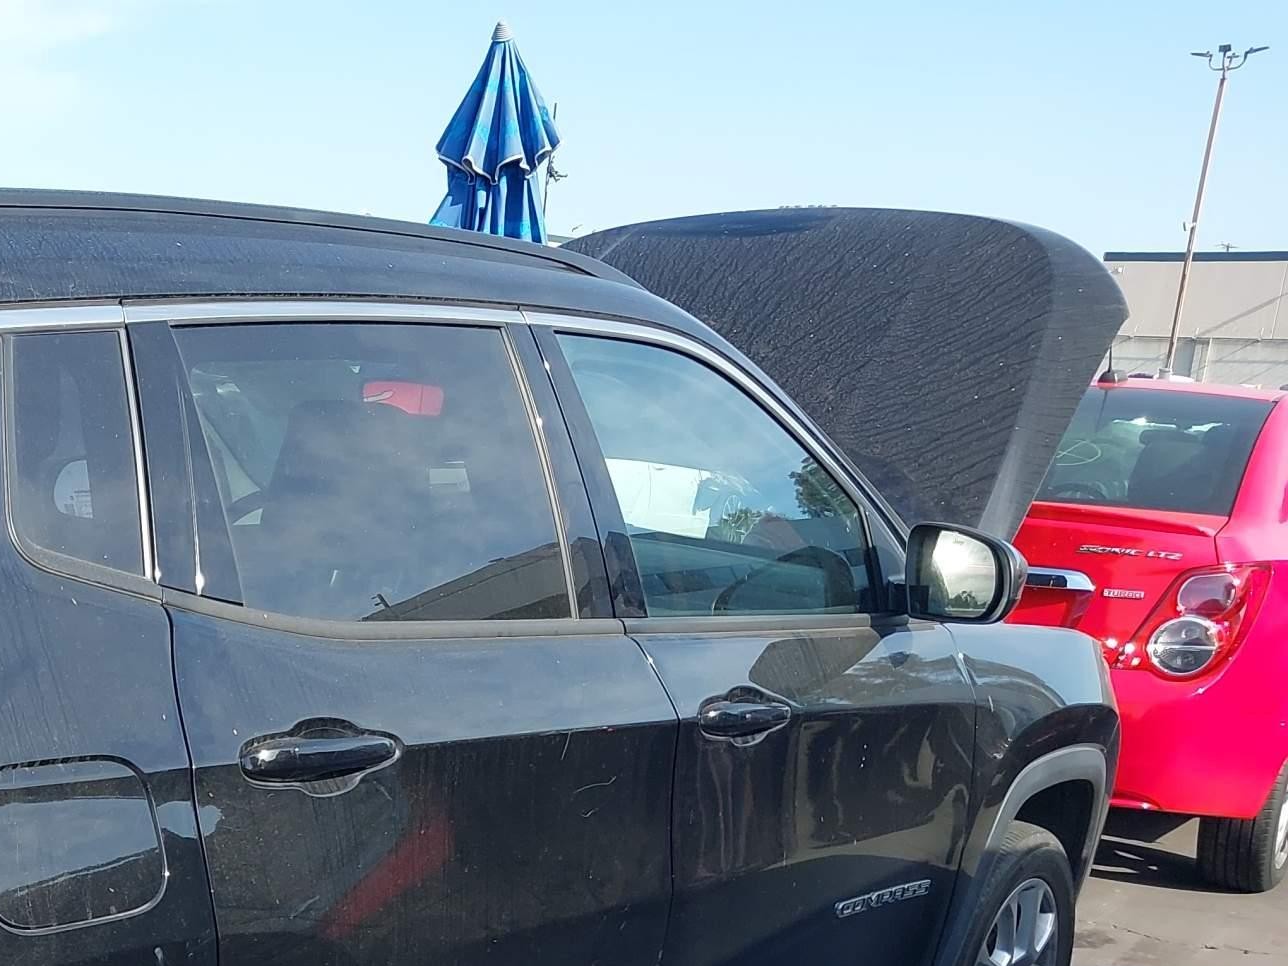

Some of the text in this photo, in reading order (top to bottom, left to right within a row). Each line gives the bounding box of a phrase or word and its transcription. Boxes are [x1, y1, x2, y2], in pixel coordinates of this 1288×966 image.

[1147, 550, 1183, 561] LTZ
[1105, 589, 1144, 599] TURBO
[834, 878, 931, 918] COMPASS
